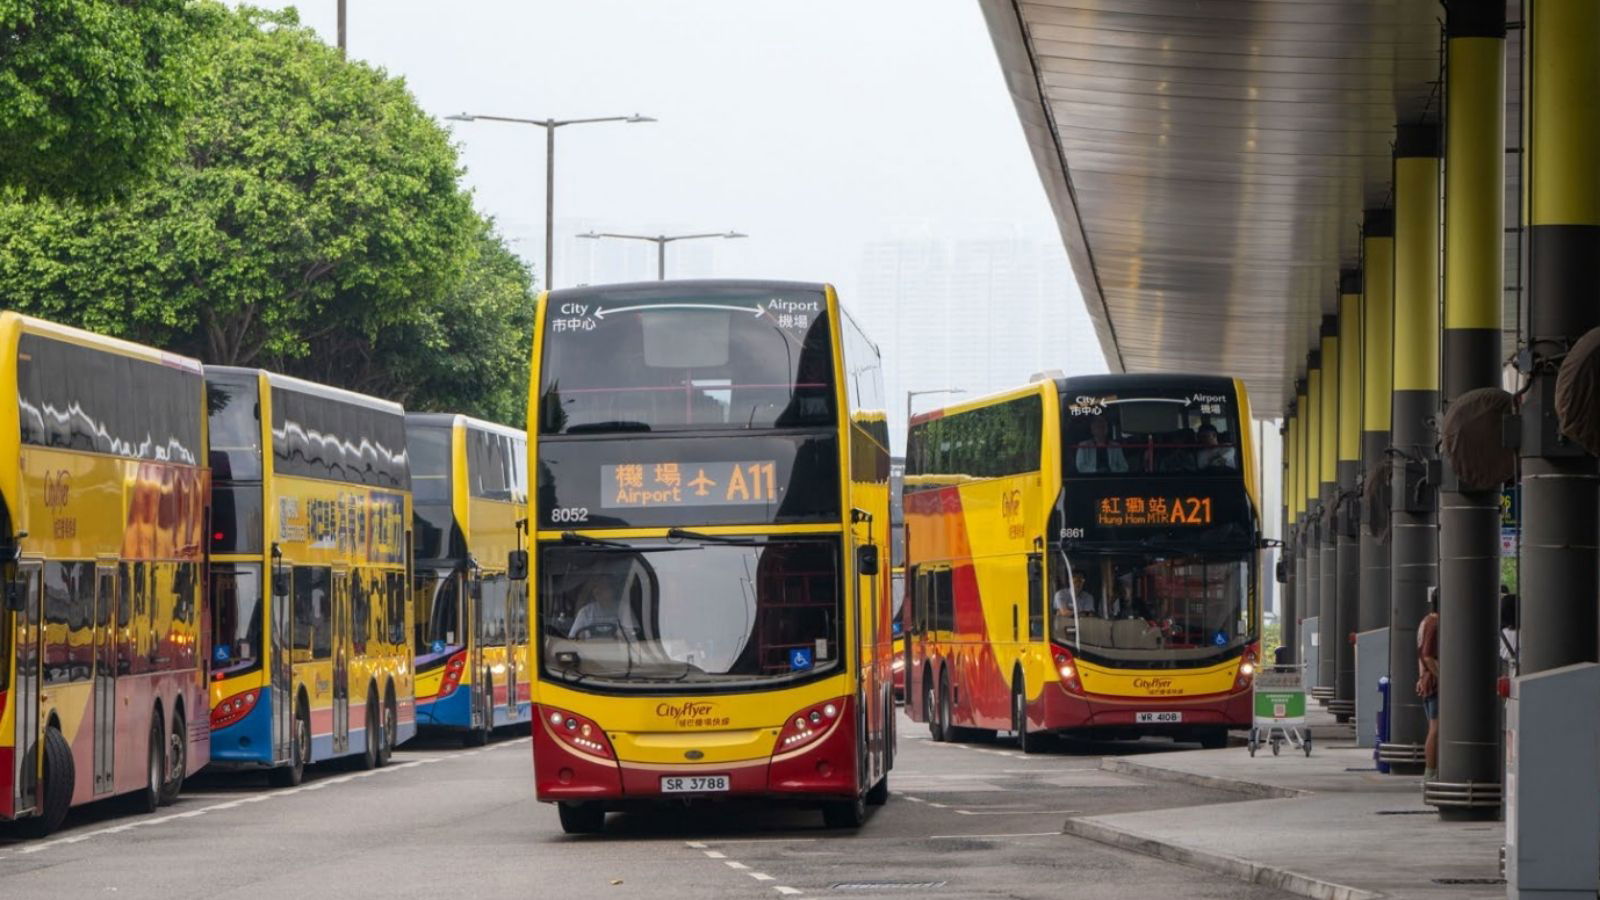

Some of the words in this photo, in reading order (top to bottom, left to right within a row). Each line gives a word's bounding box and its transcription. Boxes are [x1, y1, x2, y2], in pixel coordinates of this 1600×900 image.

[561, 302, 589, 317] City
[768, 298, 819, 313] Airport
[552, 317, 596, 332] 市中心
[777, 313, 808, 329] 機場
[1075, 395, 1096, 406] City
[1193, 393, 1227, 403] Airport
[1071, 405, 1102, 416] 市中心
[615, 462, 681, 487] 機場
[726, 462, 777, 500] A11
[616, 487, 682, 506] Airport
[551, 507, 588, 523] 8052
[1169, 497, 1212, 524] A21
[1099, 513, 1122, 526] Hung
[1125, 513, 1146, 524] Hom
[1147, 513, 1169, 524] MTR
[1060, 527, 1085, 539] 6861
[1141, 712, 1153, 721] WR
[666, 778, 684, 790] SR
[690, 777, 725, 790] 3788
